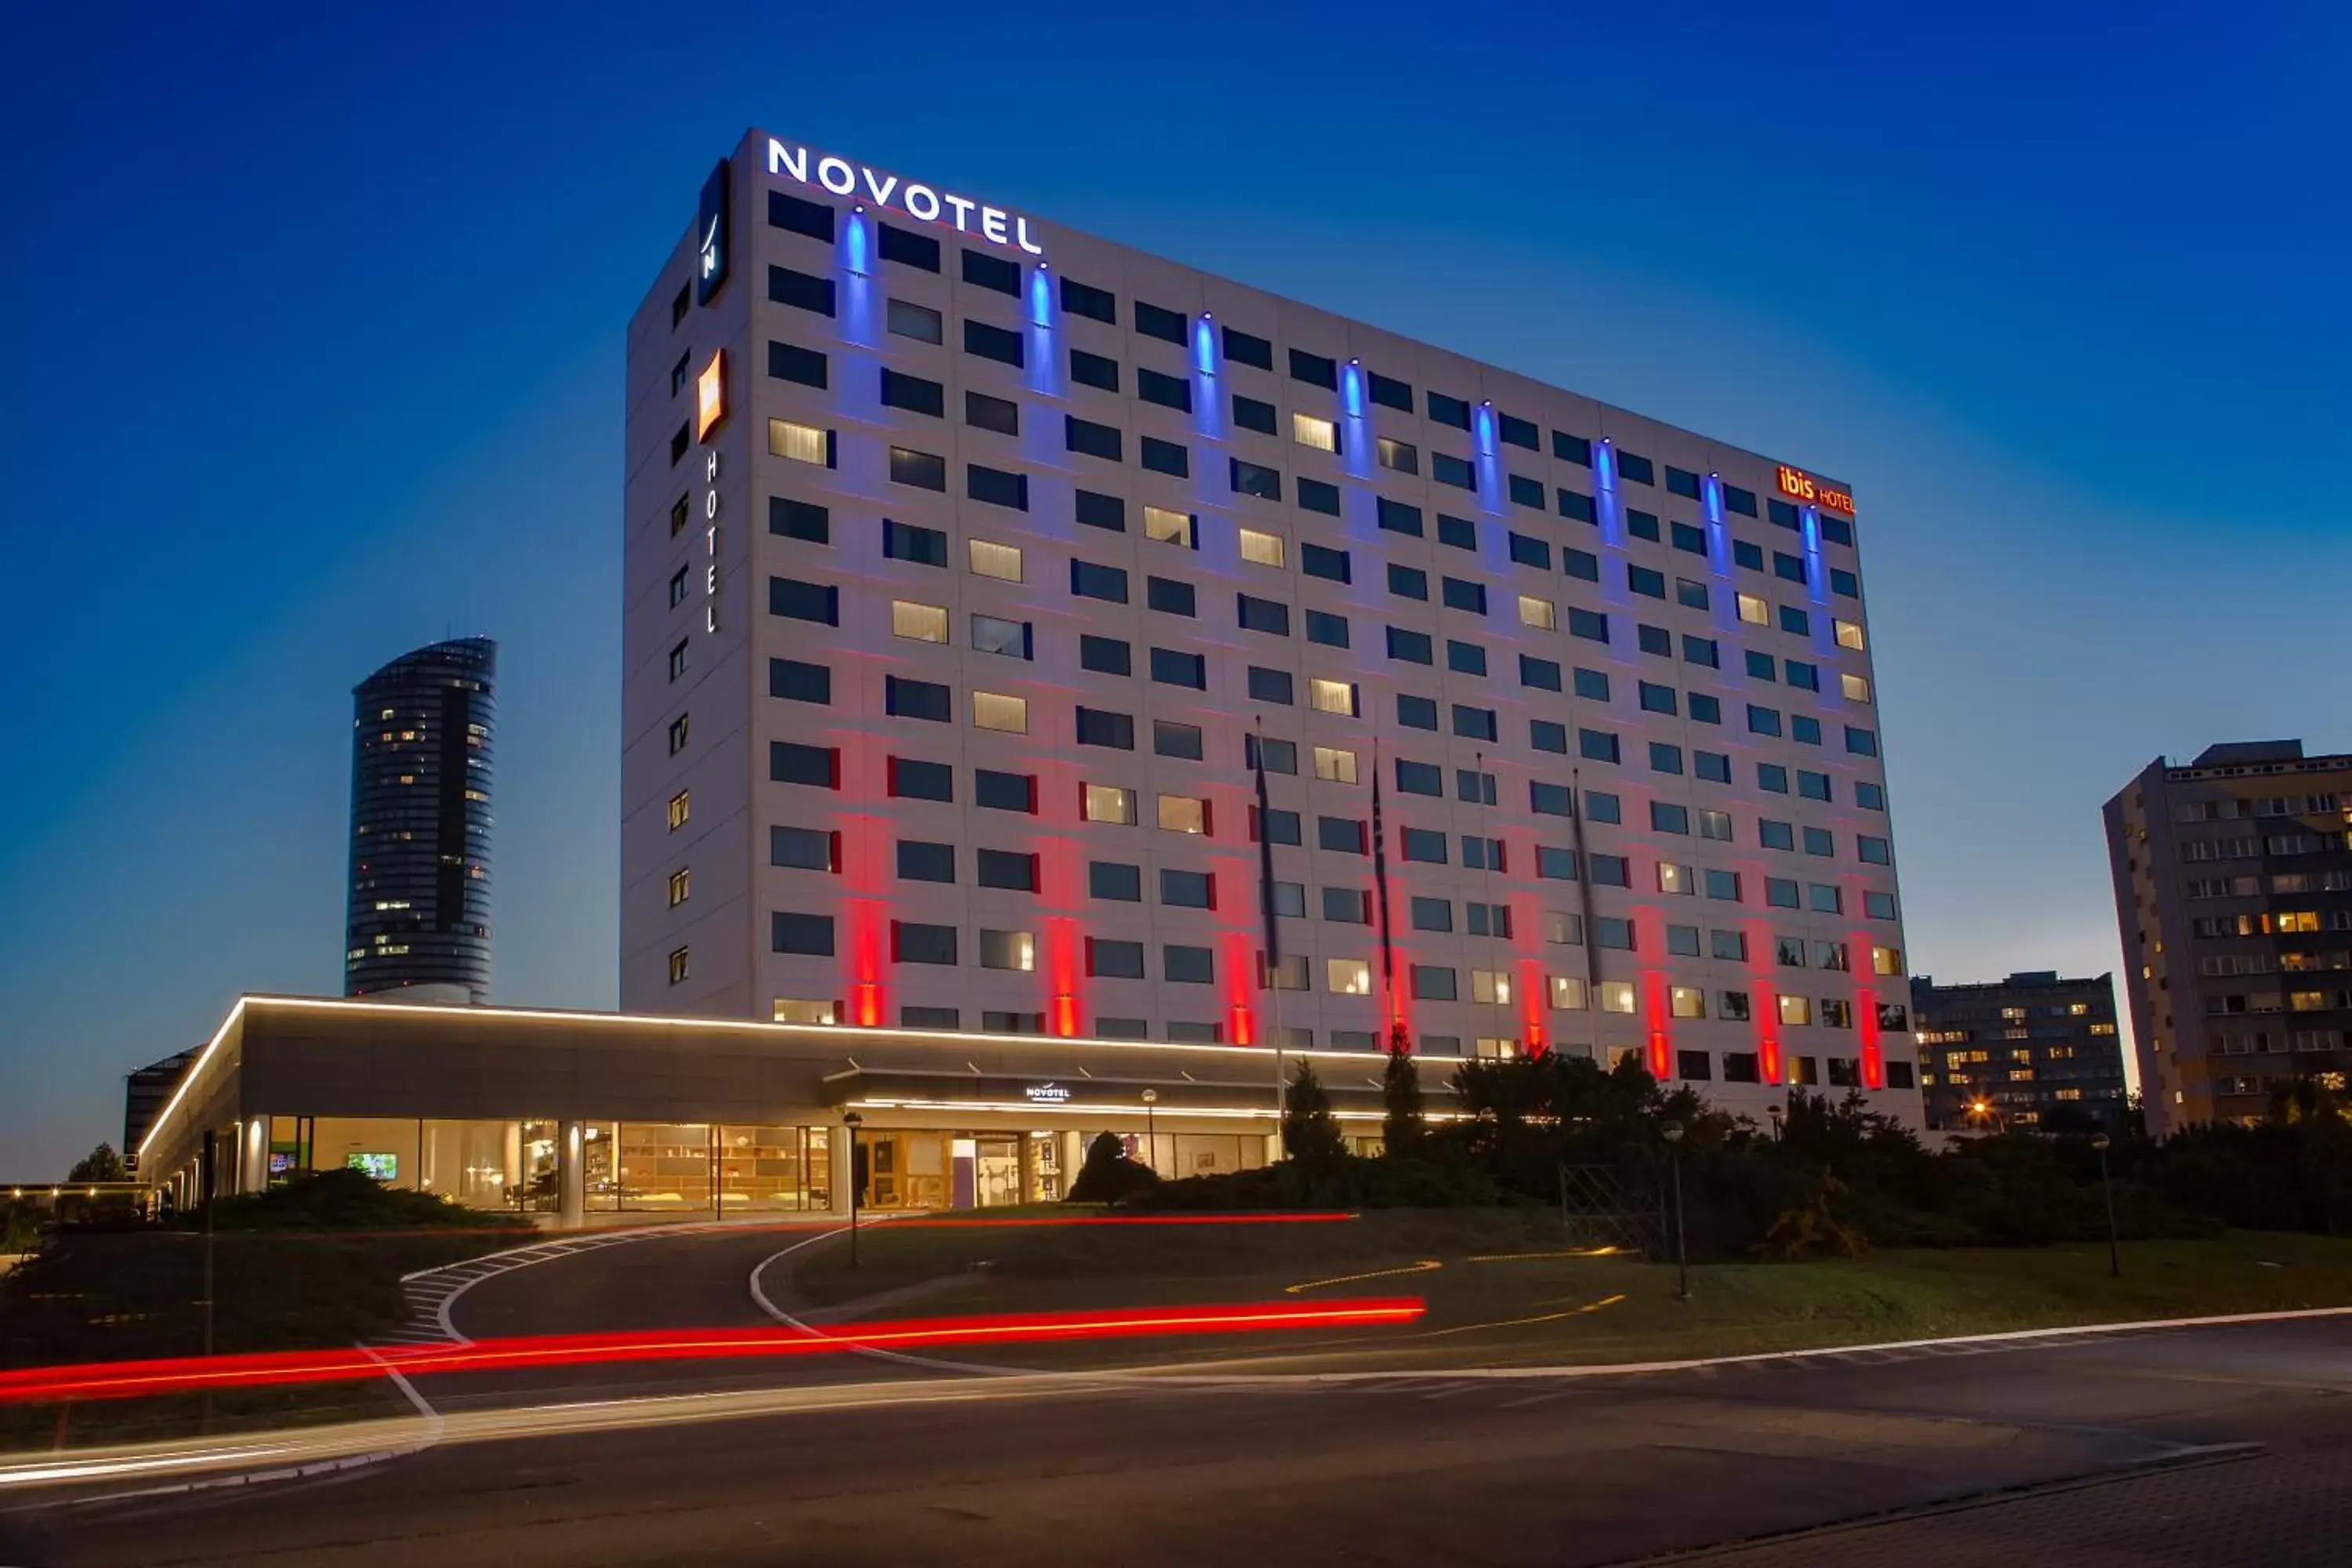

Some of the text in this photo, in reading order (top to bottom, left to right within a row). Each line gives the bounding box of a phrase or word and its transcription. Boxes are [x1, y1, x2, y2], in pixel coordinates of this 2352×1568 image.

[768, 137, 1042, 255] NOVOTEL
[1780, 466, 1857, 513] ibis HOTEL
[707, 451, 717, 633] HOTEL
[1026, 1087, 1070, 1097] NOVOTEL
